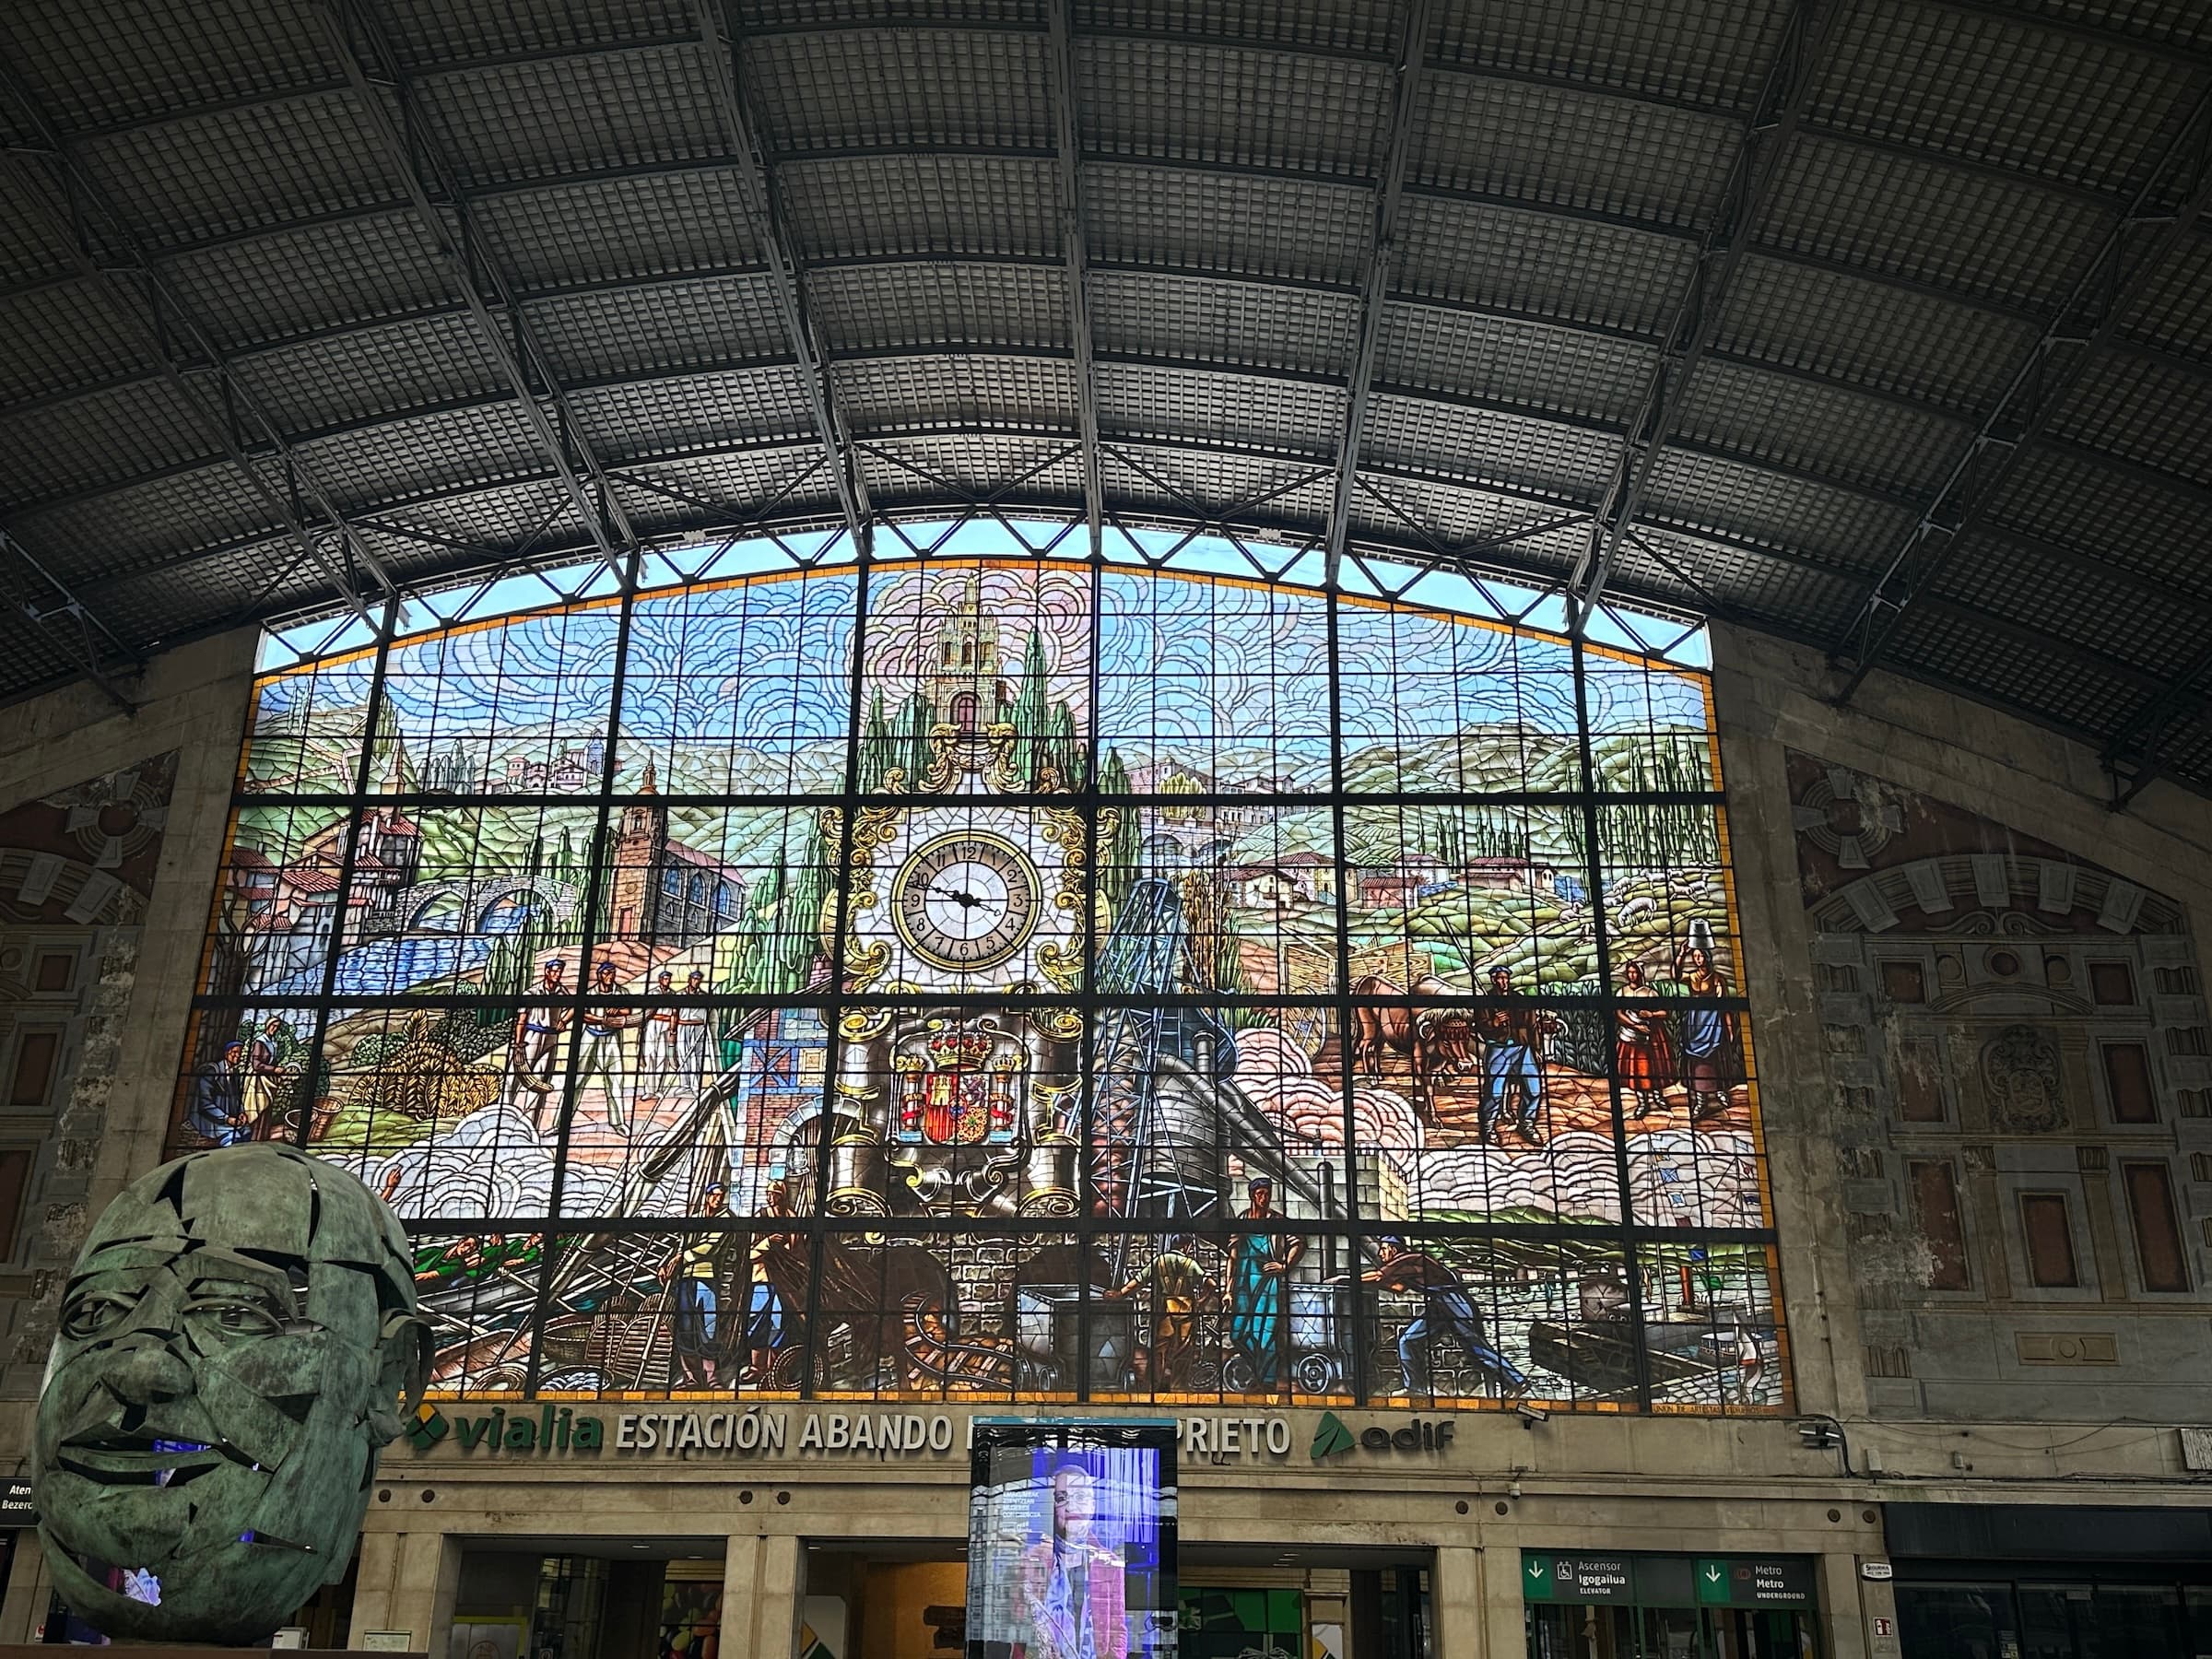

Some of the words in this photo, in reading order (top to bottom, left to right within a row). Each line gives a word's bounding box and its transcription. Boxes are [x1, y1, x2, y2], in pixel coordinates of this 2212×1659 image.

[936, 853, 946, 867] 11
[962, 846, 976, 861] 12
[917, 872, 930, 887] 10
[1007, 869, 1018, 883] 2
[911, 894, 921, 908] 9
[1013, 894, 1023, 908] 3
[916, 918, 925, 932] 8
[1005, 918, 1016, 931] 4
[935, 936, 945, 950] 7
[959, 942, 969, 956] 6
[986, 936, 995, 950] 5
[454, 1405, 604, 1449] vialia
[616, 1406, 786, 1450] ESTACIÓN
[798, 1414, 953, 1451] ABANDO
[1360, 1418, 1455, 1451] adif
[9, 1485, 31, 1495] Aten
[1578, 1561, 1621, 1571] Ascensor
[1755, 1565, 1783, 1575] Metro
[1578, 1573, 1626, 1586] Igogailua
[1757, 1579, 1784, 1589] Metro
[1757, 1592, 1806, 1600] UNDERGROUND
